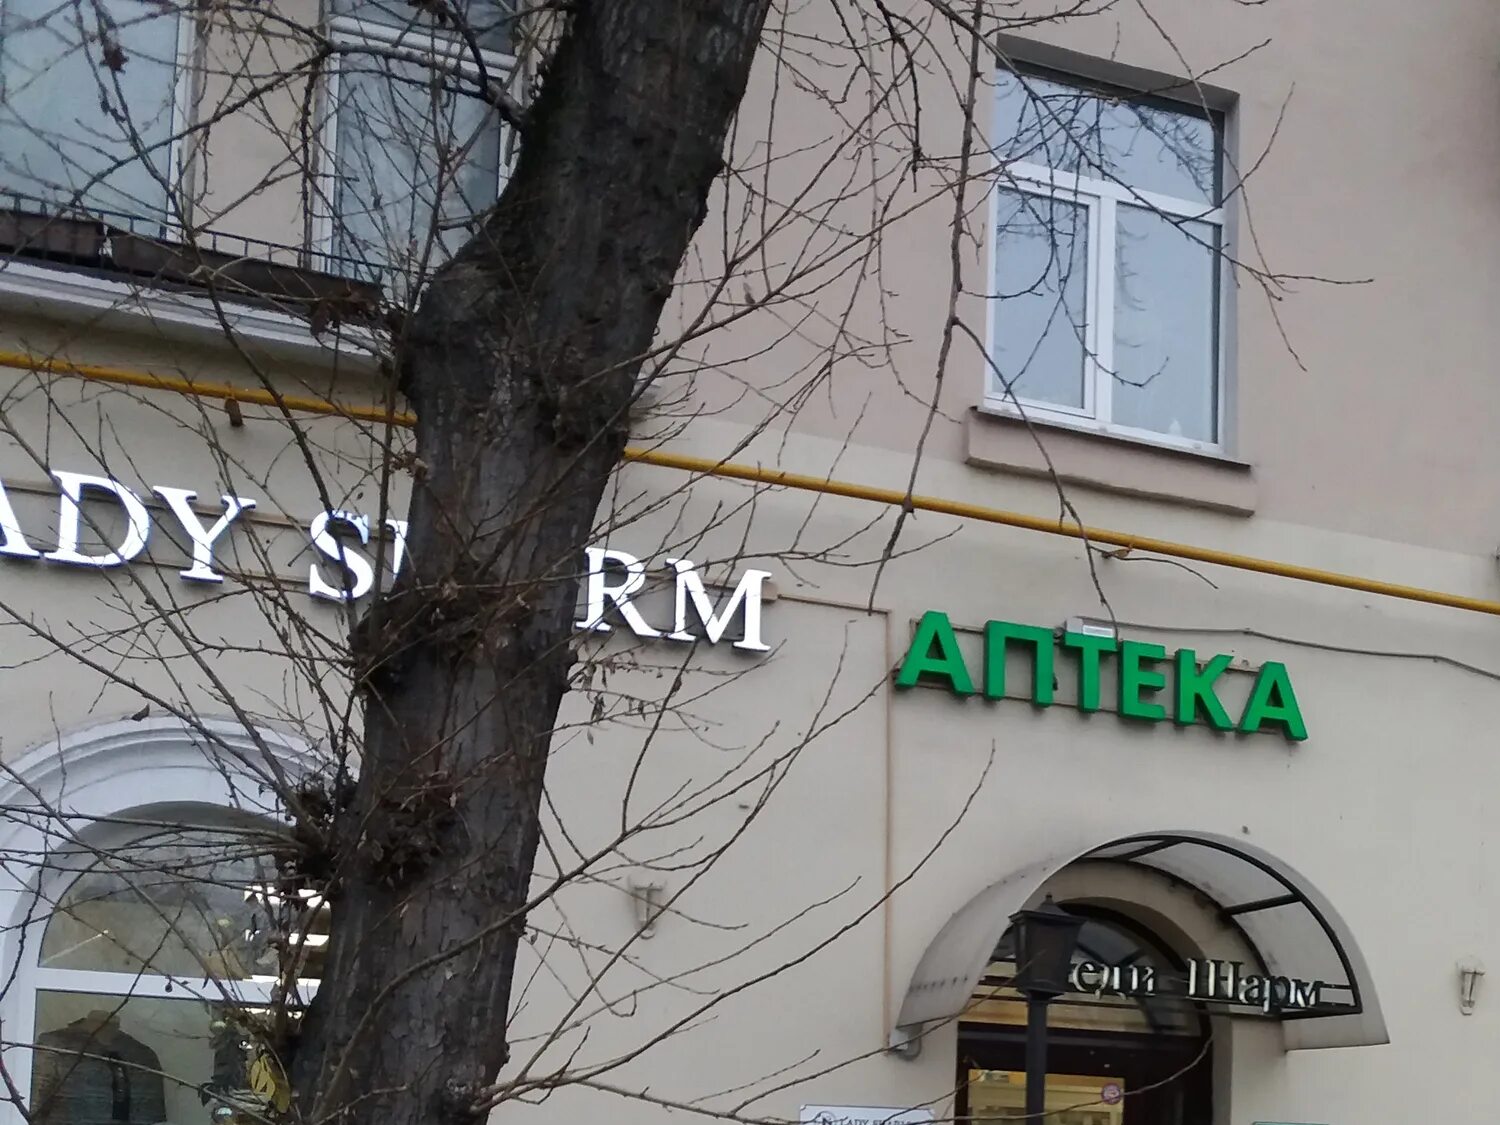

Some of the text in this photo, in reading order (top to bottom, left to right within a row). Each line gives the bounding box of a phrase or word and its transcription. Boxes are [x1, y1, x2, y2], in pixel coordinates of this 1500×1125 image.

[308, 508, 771, 652] SRM
[895, 610, 1308, 741] АПТЕКА
[1187, 957, 1324, 1013] Шарм
